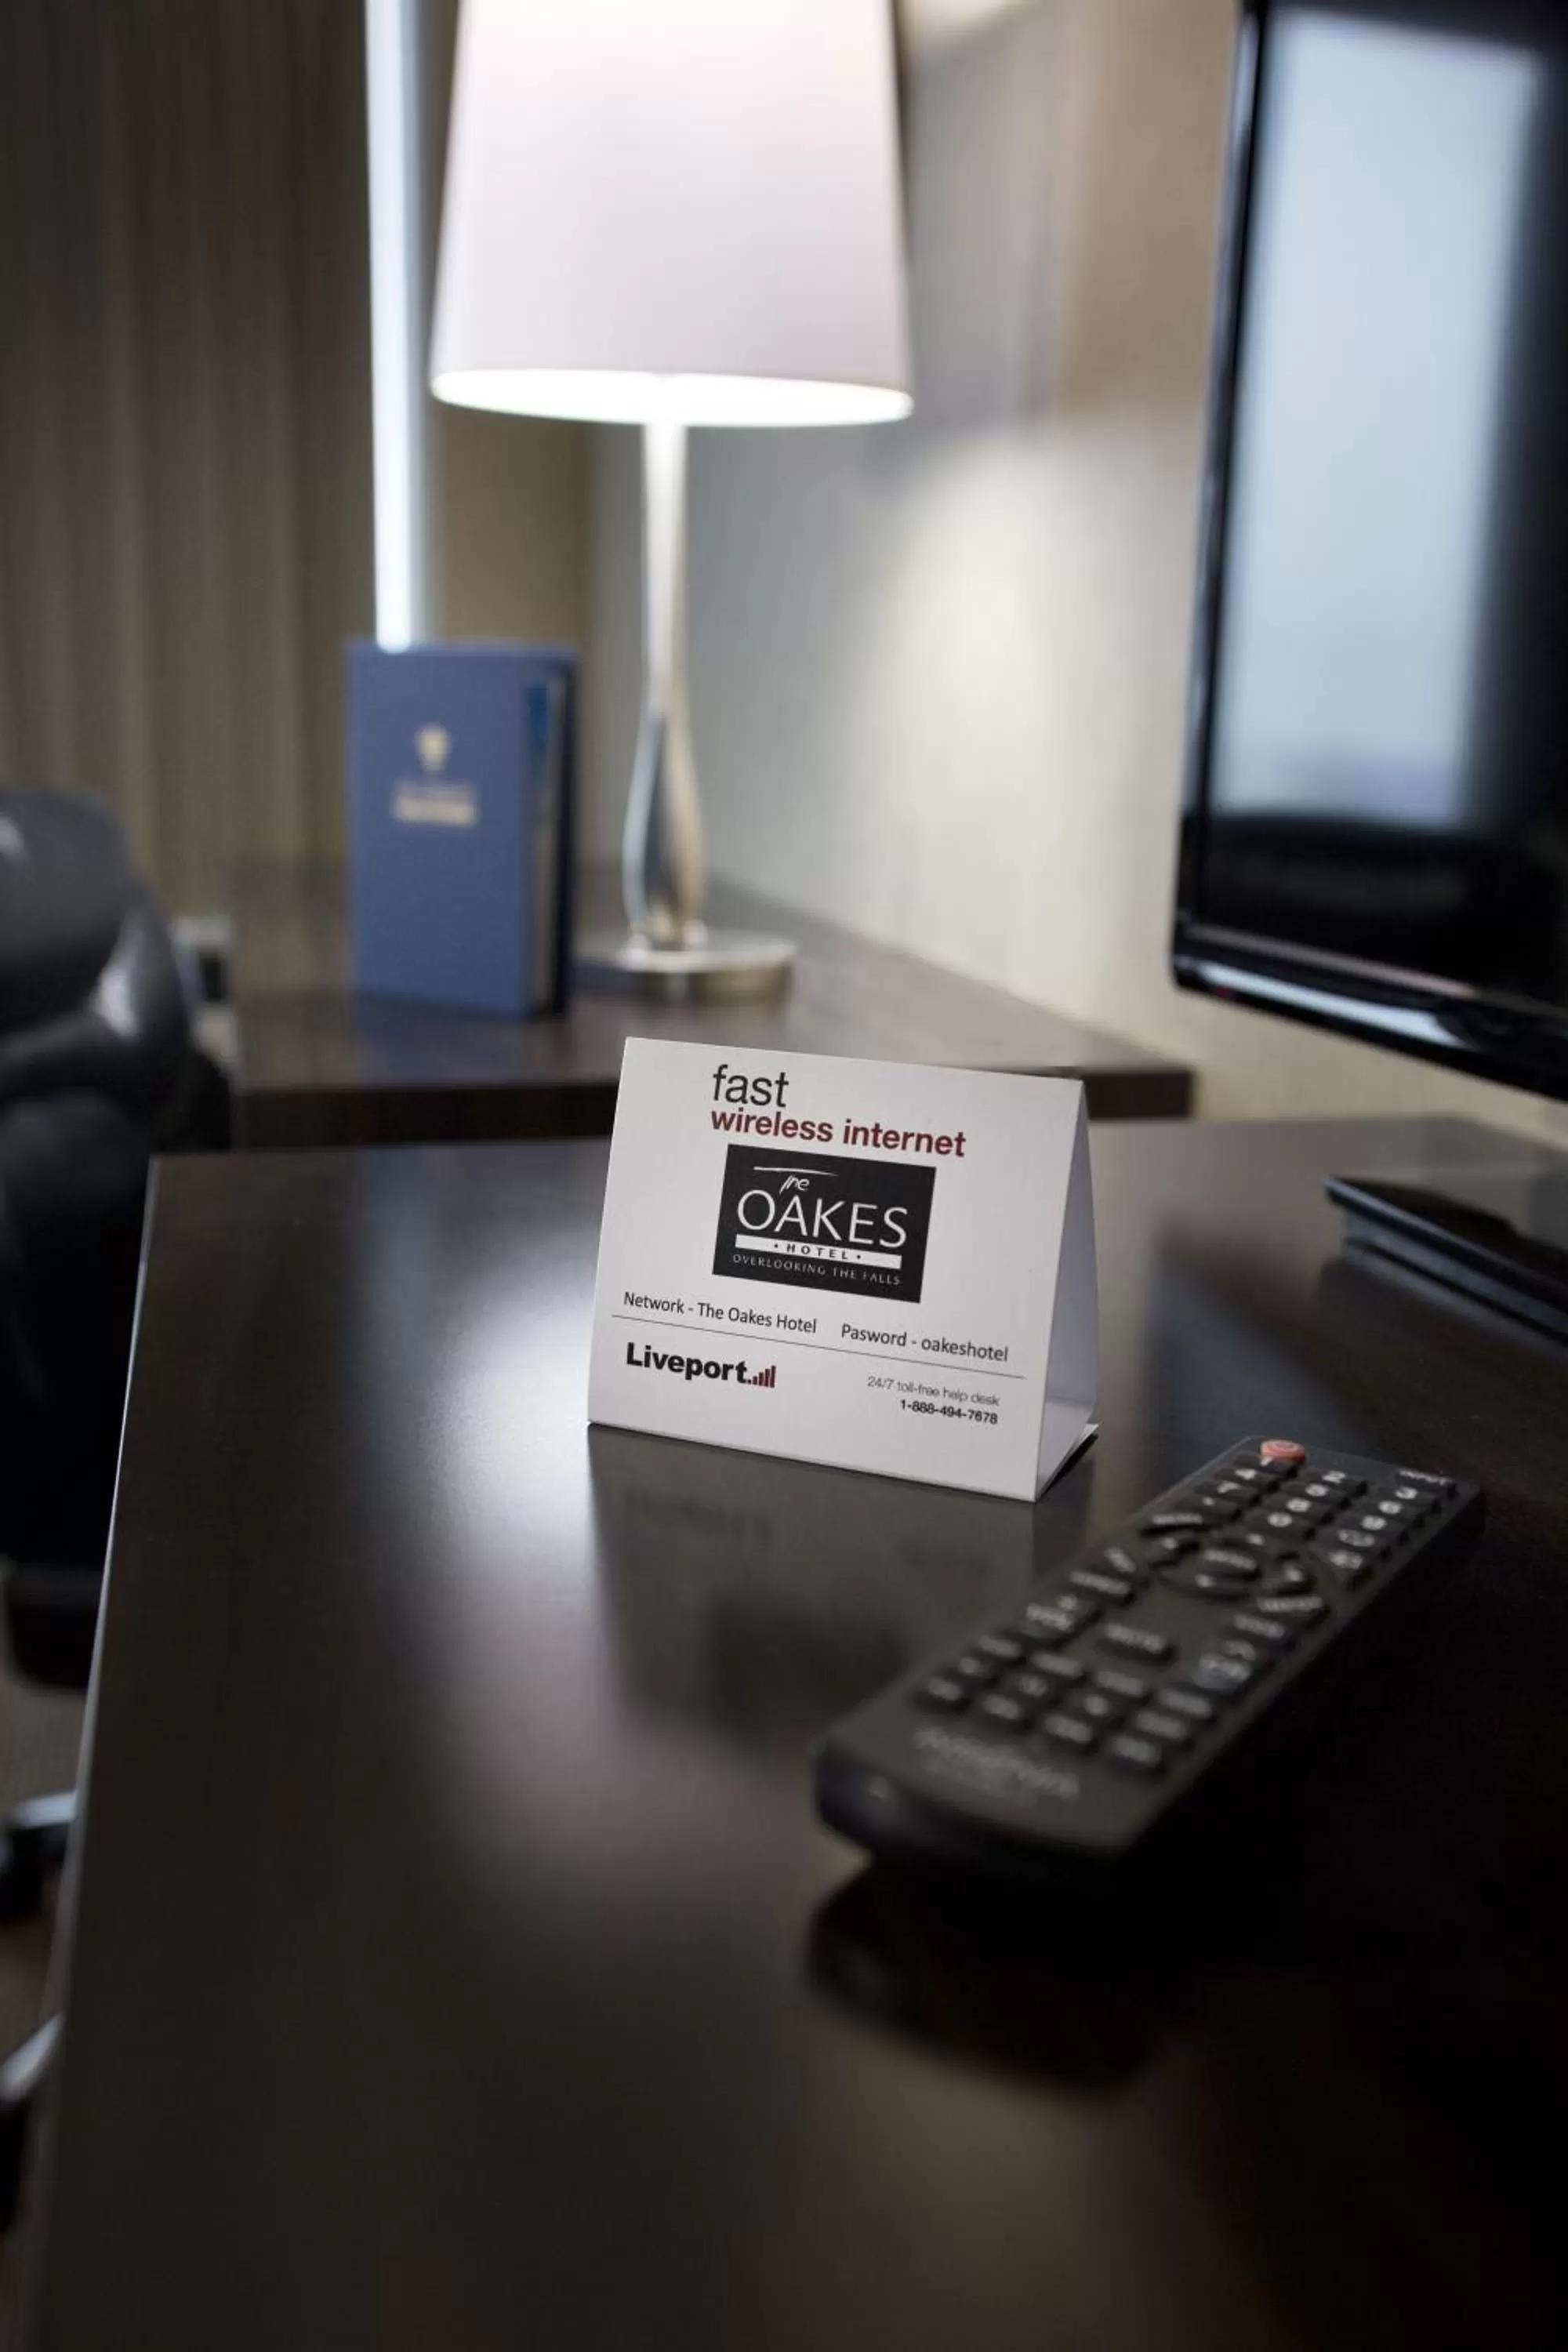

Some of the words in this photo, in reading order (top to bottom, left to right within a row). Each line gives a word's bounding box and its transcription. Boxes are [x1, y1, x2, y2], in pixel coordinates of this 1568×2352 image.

[713, 1064, 789, 1107] fast
[711, 1106, 833, 1142] wireless
[842, 1118, 966, 1157] internet
[738, 1189, 908, 1247] OAKES
[731, 1253, 826, 1276] OVERLOOKING
[833, 1266, 856, 1279] THE
[786, 1243, 848, 1259] HOTEL
[623, 1291, 684, 1315] Network
[698, 1302, 724, 1319] The
[728, 1307, 771, 1327] Oakes
[776, 1313, 817, 1334] Hotel
[841, 1323, 906, 1347] Pasword
[921, 1337, 1008, 1362] oakeshotel
[626, 1342, 747, 1384] Liveport
[867, 1376, 894, 1390] 24/7
[897, 1381, 940, 1397] toll-free
[943, 1386, 967, 1403] help
[971, 1392, 1000, 1406] desk
[900, 1399, 998, 1425] 1-888-494-7678
